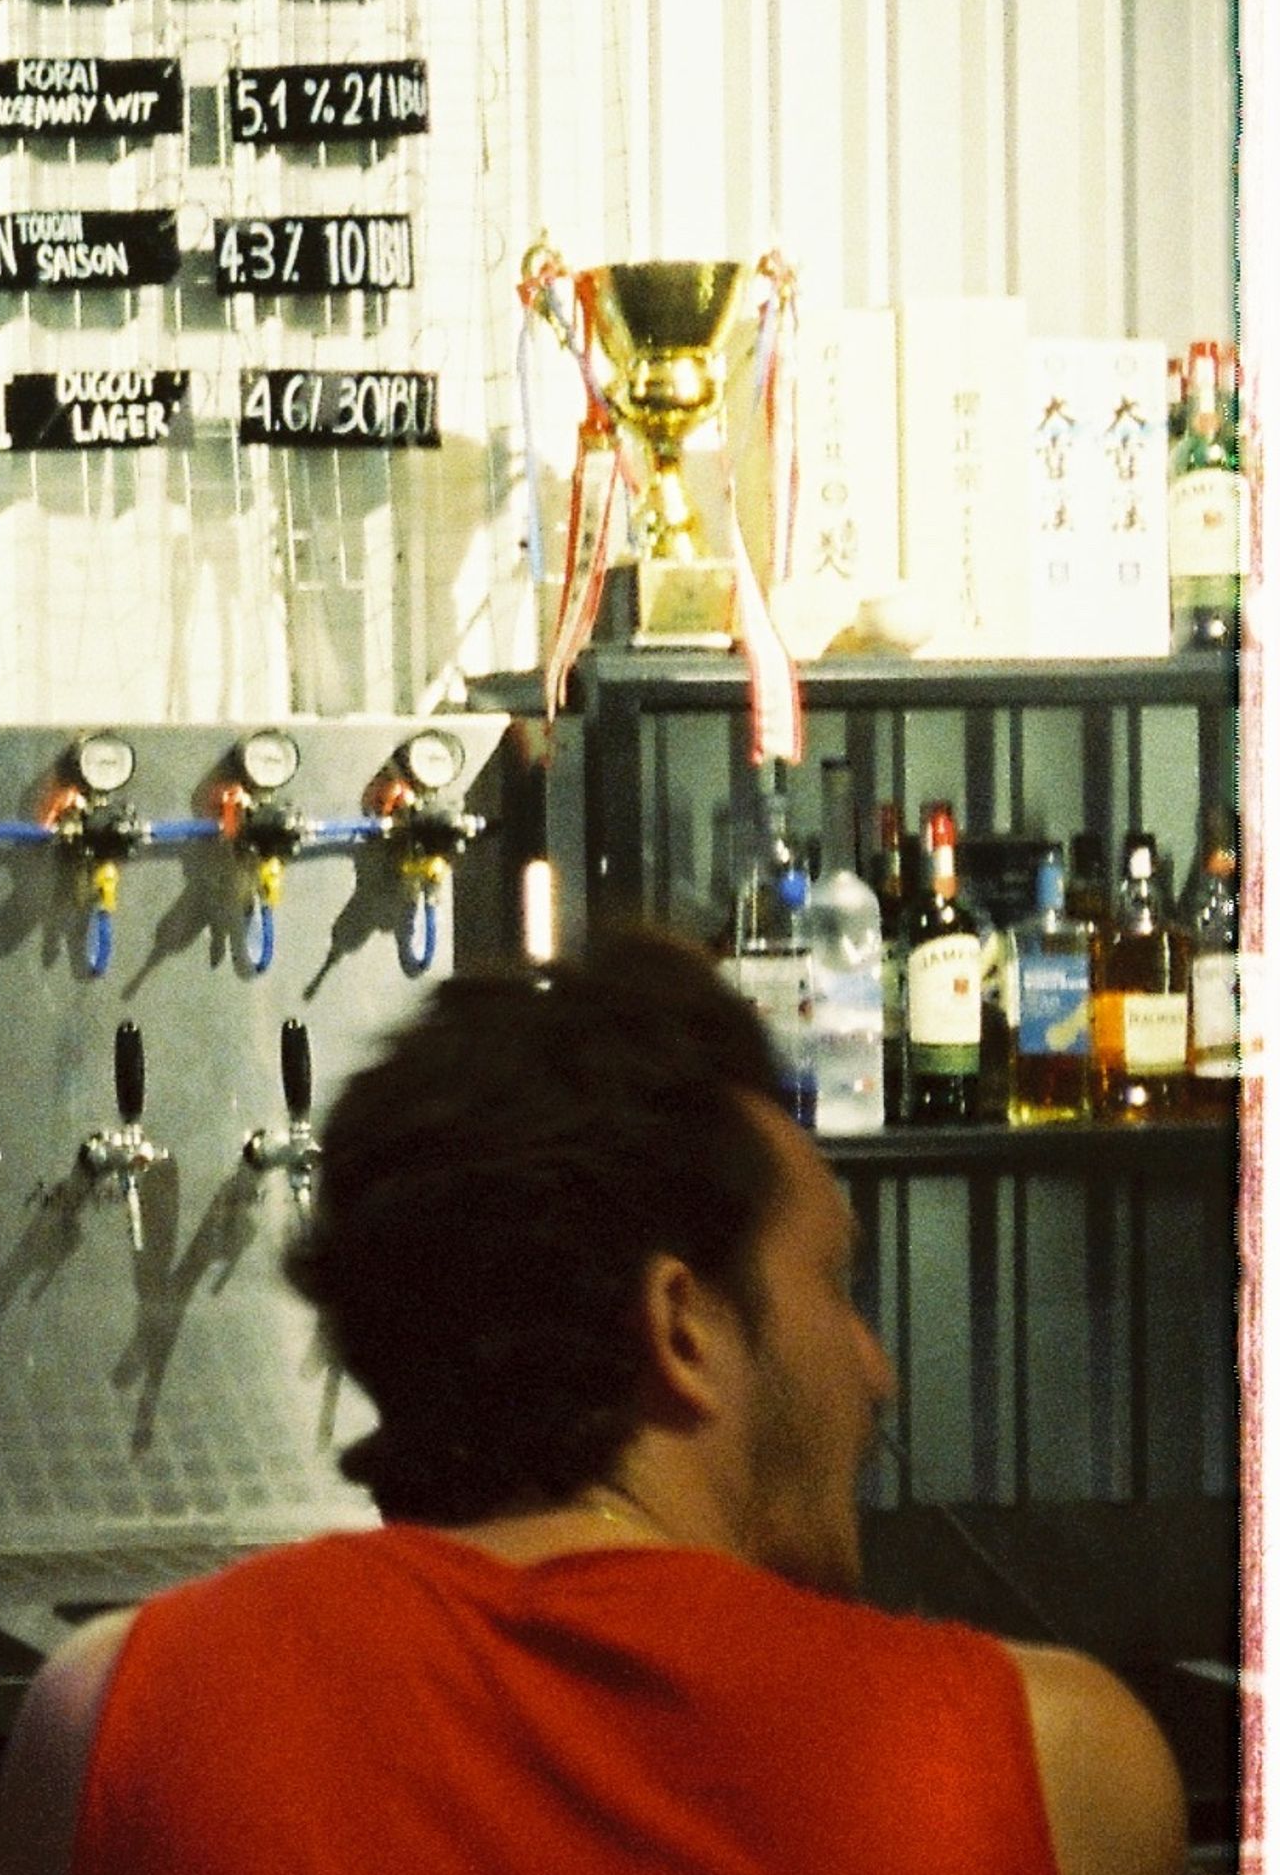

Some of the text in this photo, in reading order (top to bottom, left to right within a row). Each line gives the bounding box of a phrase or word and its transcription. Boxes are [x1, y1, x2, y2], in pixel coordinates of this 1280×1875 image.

[103, 91, 159, 127] WIT
[38, 242, 130, 283] SAISON
[219, 221, 304, 283] 4.3%
[70, 401, 169, 443] LAGER
